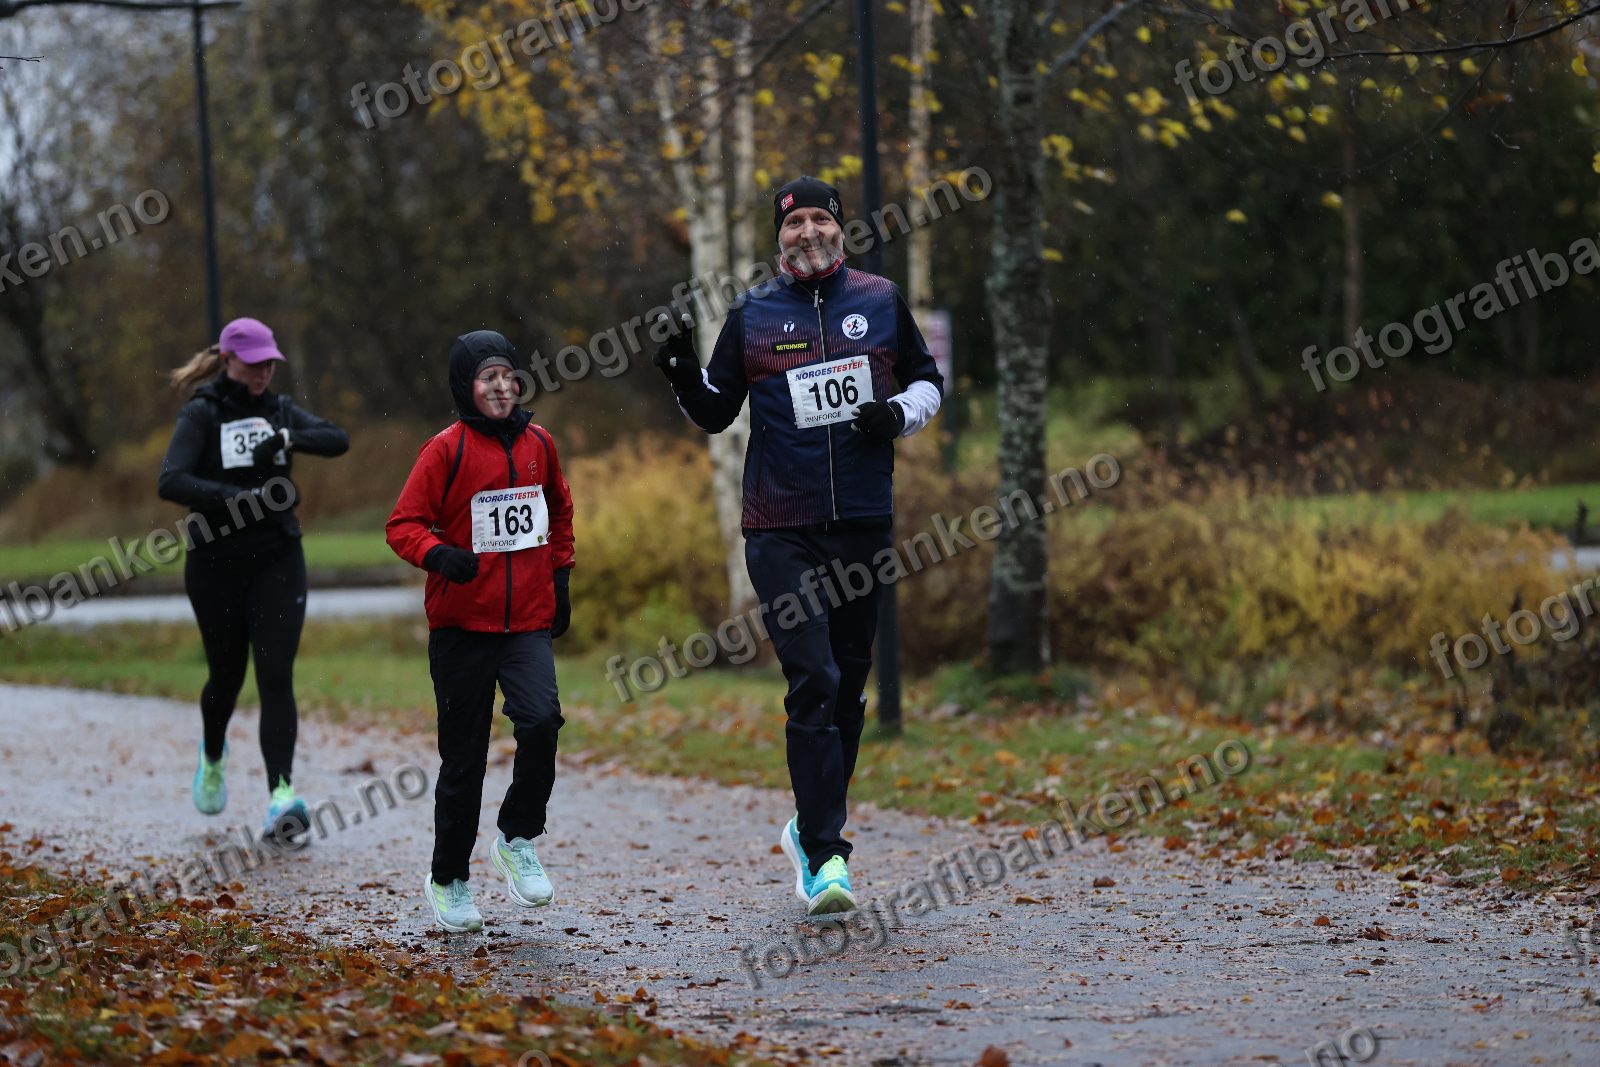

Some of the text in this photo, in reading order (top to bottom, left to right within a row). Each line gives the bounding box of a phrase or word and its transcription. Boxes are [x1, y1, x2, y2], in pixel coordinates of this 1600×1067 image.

[795, 360, 864, 382] NORGESTESTEN
[808, 375, 859, 411] 106
[804, 411, 842, 423] WINFORCE
[477, 490, 540, 503] NORGESTESTEN
[488, 504, 534, 537] 163
[480, 538, 517, 548] WINFORCE
